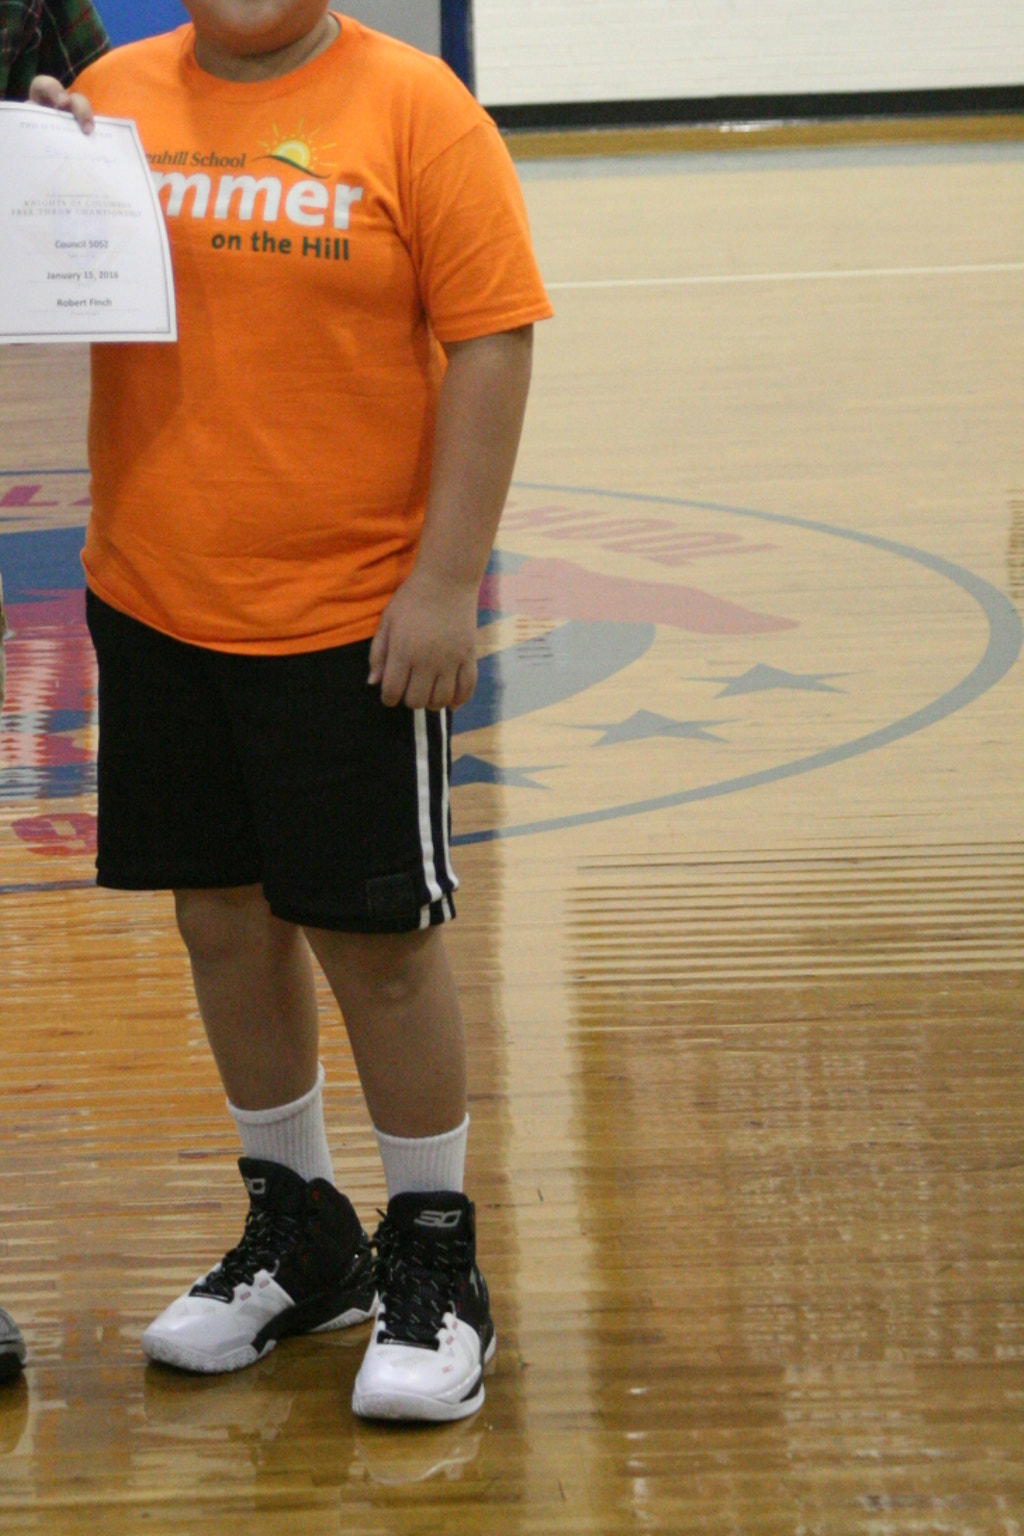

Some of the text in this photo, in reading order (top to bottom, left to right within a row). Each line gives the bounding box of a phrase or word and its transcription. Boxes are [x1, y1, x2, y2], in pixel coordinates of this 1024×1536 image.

[190, 151, 246, 168] School
[55, 240, 86, 249] Council
[212, 230, 349, 260] on the Hill
[46, 271, 81, 280] January
[98, 271, 119, 279] 2016
[56, 298, 112, 307] Robert Finch
